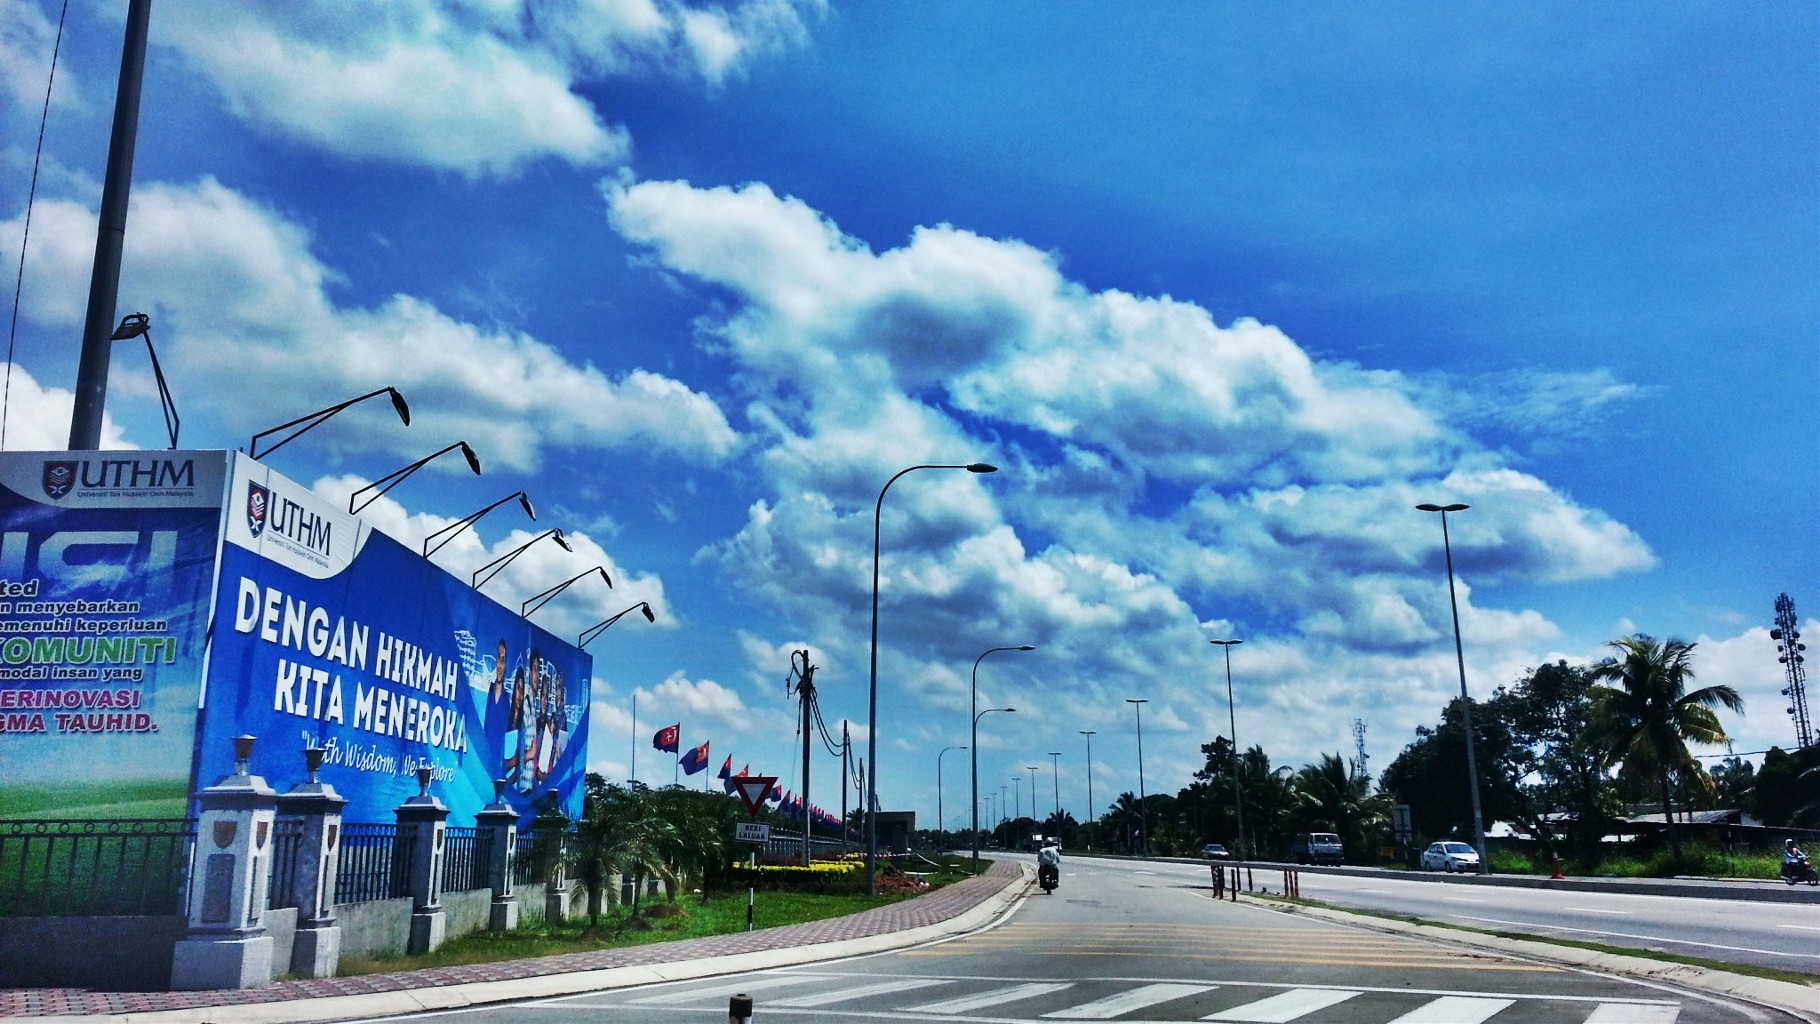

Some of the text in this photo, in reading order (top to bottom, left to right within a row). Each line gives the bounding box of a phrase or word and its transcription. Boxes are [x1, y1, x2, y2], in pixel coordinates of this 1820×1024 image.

[80, 459, 194, 487] UTHM
[270, 492, 331, 556] UTHM
[16, 599, 140, 616] menyebarkan
[76, 618, 167, 634] keperluan
[235, 576, 459, 701] DENGAN HIKMAH
[0, 637, 177, 665] OMUNITI
[0, 666, 144, 682] modal insan yang
[0, 689, 140, 708] ERINOVASI
[274, 659, 468, 754] KITA MENEROKA
[55, 713, 159, 733] TAUHID.
[345, 741, 397, 779] Wisdom,
